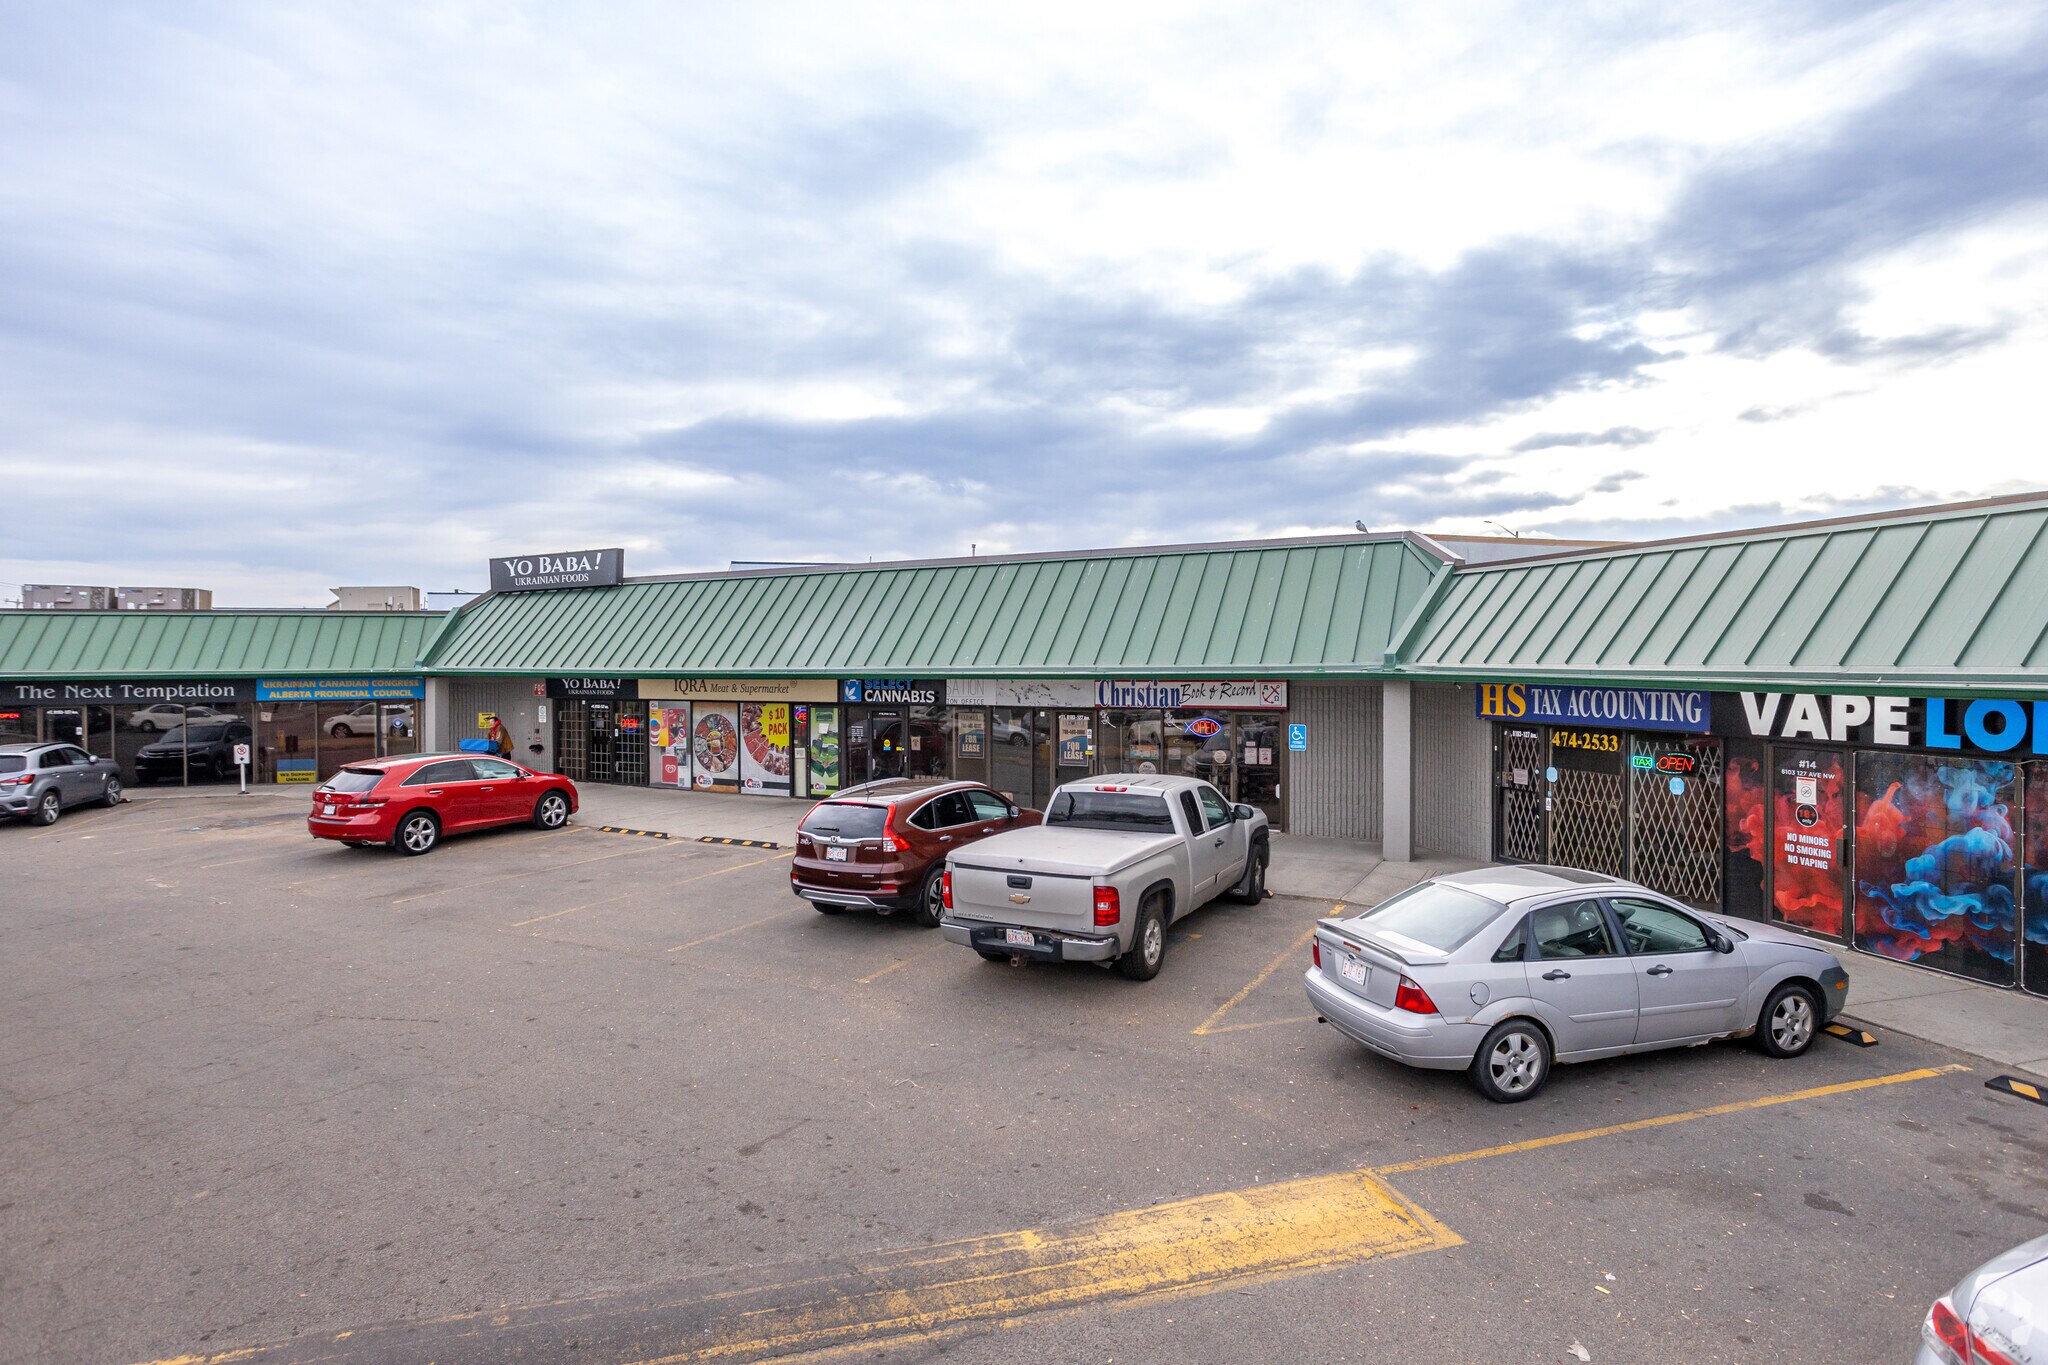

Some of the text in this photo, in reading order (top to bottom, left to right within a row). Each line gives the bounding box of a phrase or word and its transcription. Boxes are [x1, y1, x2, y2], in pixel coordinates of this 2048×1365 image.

[503, 552, 602, 577] YO BABA!
[514, 573, 590, 587] UKRAINIAN FOODS
[262, 679, 420, 688] UKRAINIAN CANADIAN CONGRESS
[673, 679, 790, 696] IQRA Meat & Supermarket
[864, 678, 913, 690] SELECT
[15, 683, 235, 701] The Next Temptation
[269, 689, 413, 699] ALBERTA PROVINCIAL COUNCIL
[864, 690, 935, 704] CANNABIS
[1099, 680, 1181, 708] Christian
[1179, 683, 1206, 704] Book
[1220, 682, 1257, 698] Record
[1480, 683, 1702, 724] HS TAX ACCOUNTING
[768, 707, 785, 721] $ 10
[1740, 691, 1910, 746] VAPE
[768, 723, 788, 736] PACK
[1191, 720, 1219, 734] OPEN
[965, 735, 977, 743] FOR
[1066, 741, 1080, 750] FOR
[1551, 731, 1619, 752] 474-2533
[962, 744, 981, 752] LEASE
[1063, 751, 1084, 760] LEASE
[1635, 758, 1651, 767] TAX
[1657, 756, 1693, 771] OPEN
[1798, 760, 1817, 769] #14
[1798, 809, 1816, 818] 18+
[1786, 833, 1830, 847] NO MINORS
[1784, 844, 1832, 859] NO SMOKING
[1787, 854, 1829, 870] NO VAPING
